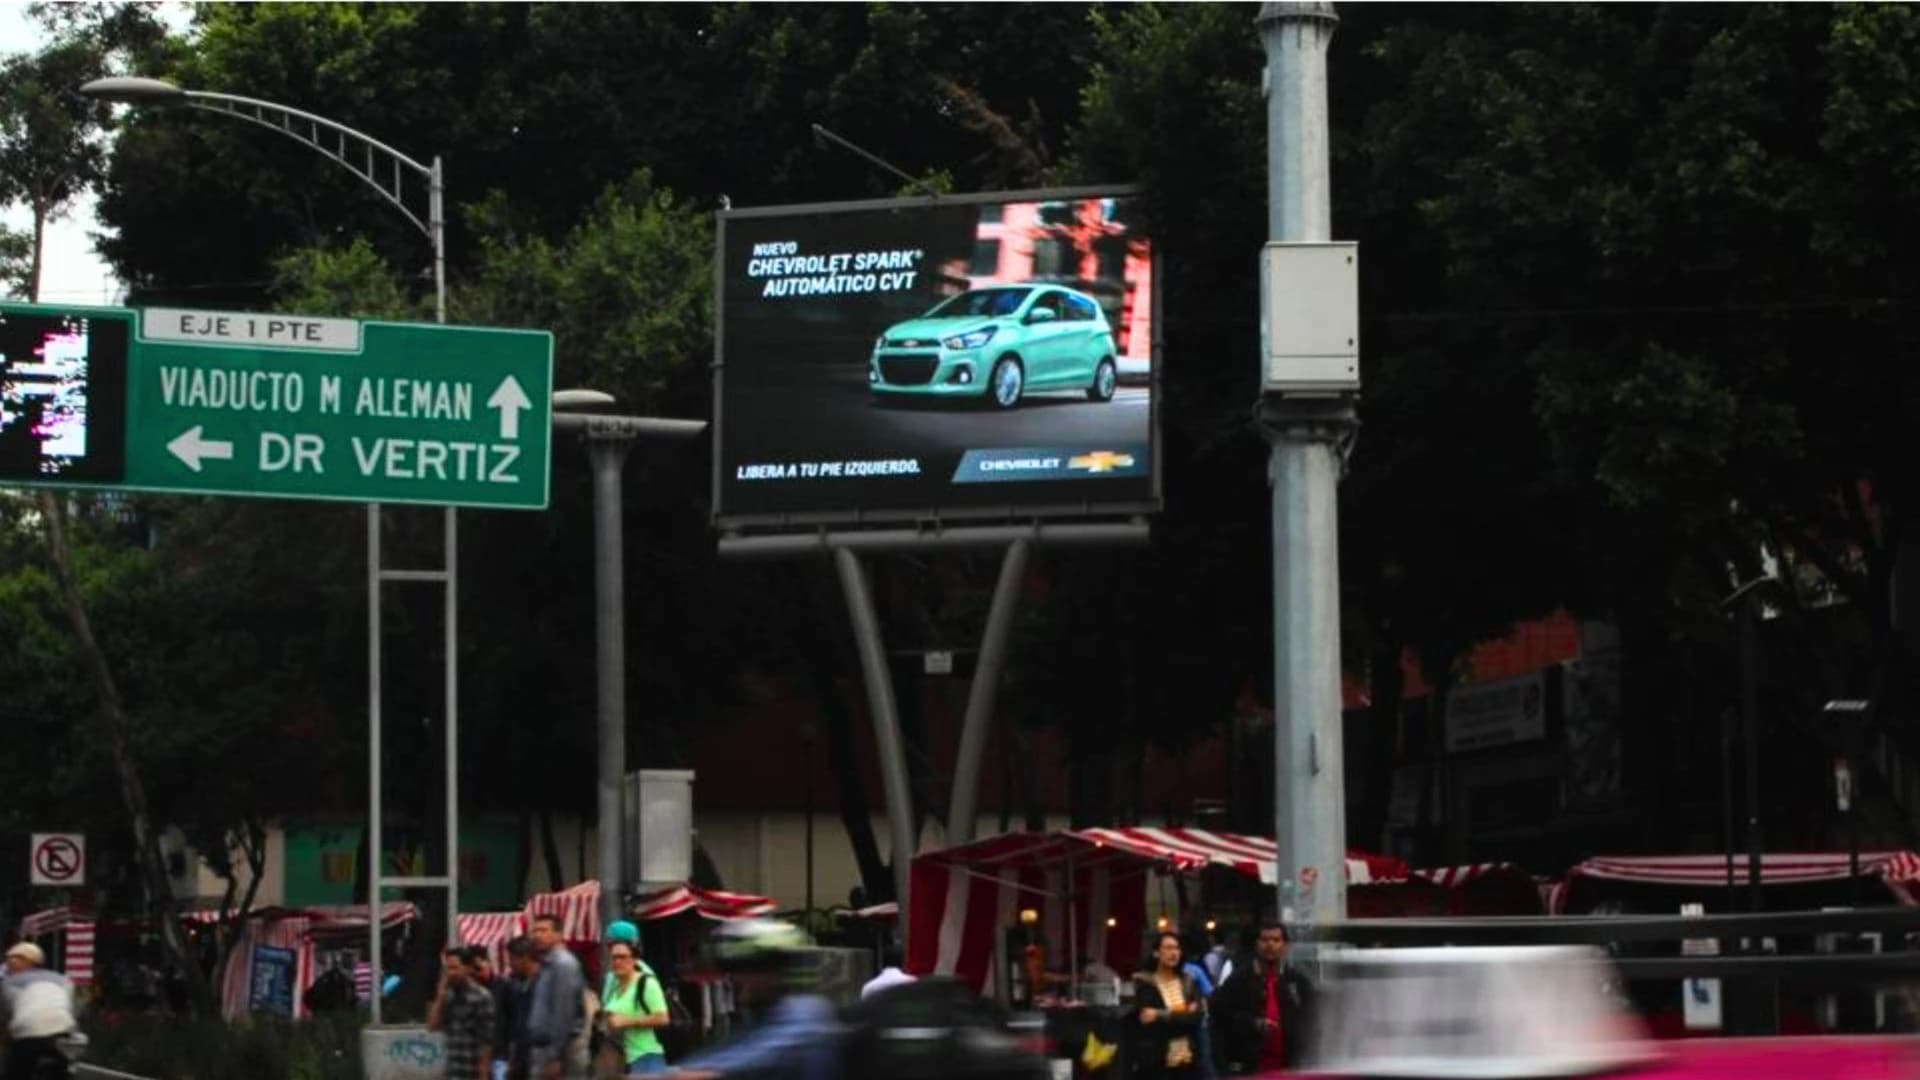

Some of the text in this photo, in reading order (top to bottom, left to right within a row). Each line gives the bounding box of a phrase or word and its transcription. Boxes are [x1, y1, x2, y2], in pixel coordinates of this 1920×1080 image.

[753, 242, 797, 256] NUEVO
[748, 254, 852, 276] CHEVROLET
[762, 270, 917, 297] AUTOMÁTICO CVT
[179, 315, 323, 342] EJE 1 PTE
[160, 365, 473, 421] VIADUCTO M ALEMAN
[258, 431, 520, 483] DR VERTIZ
[736, 458, 921, 481] LIBERA A TU PIE IZQUIERDO.
[979, 457, 1062, 472] CHEVROLET
